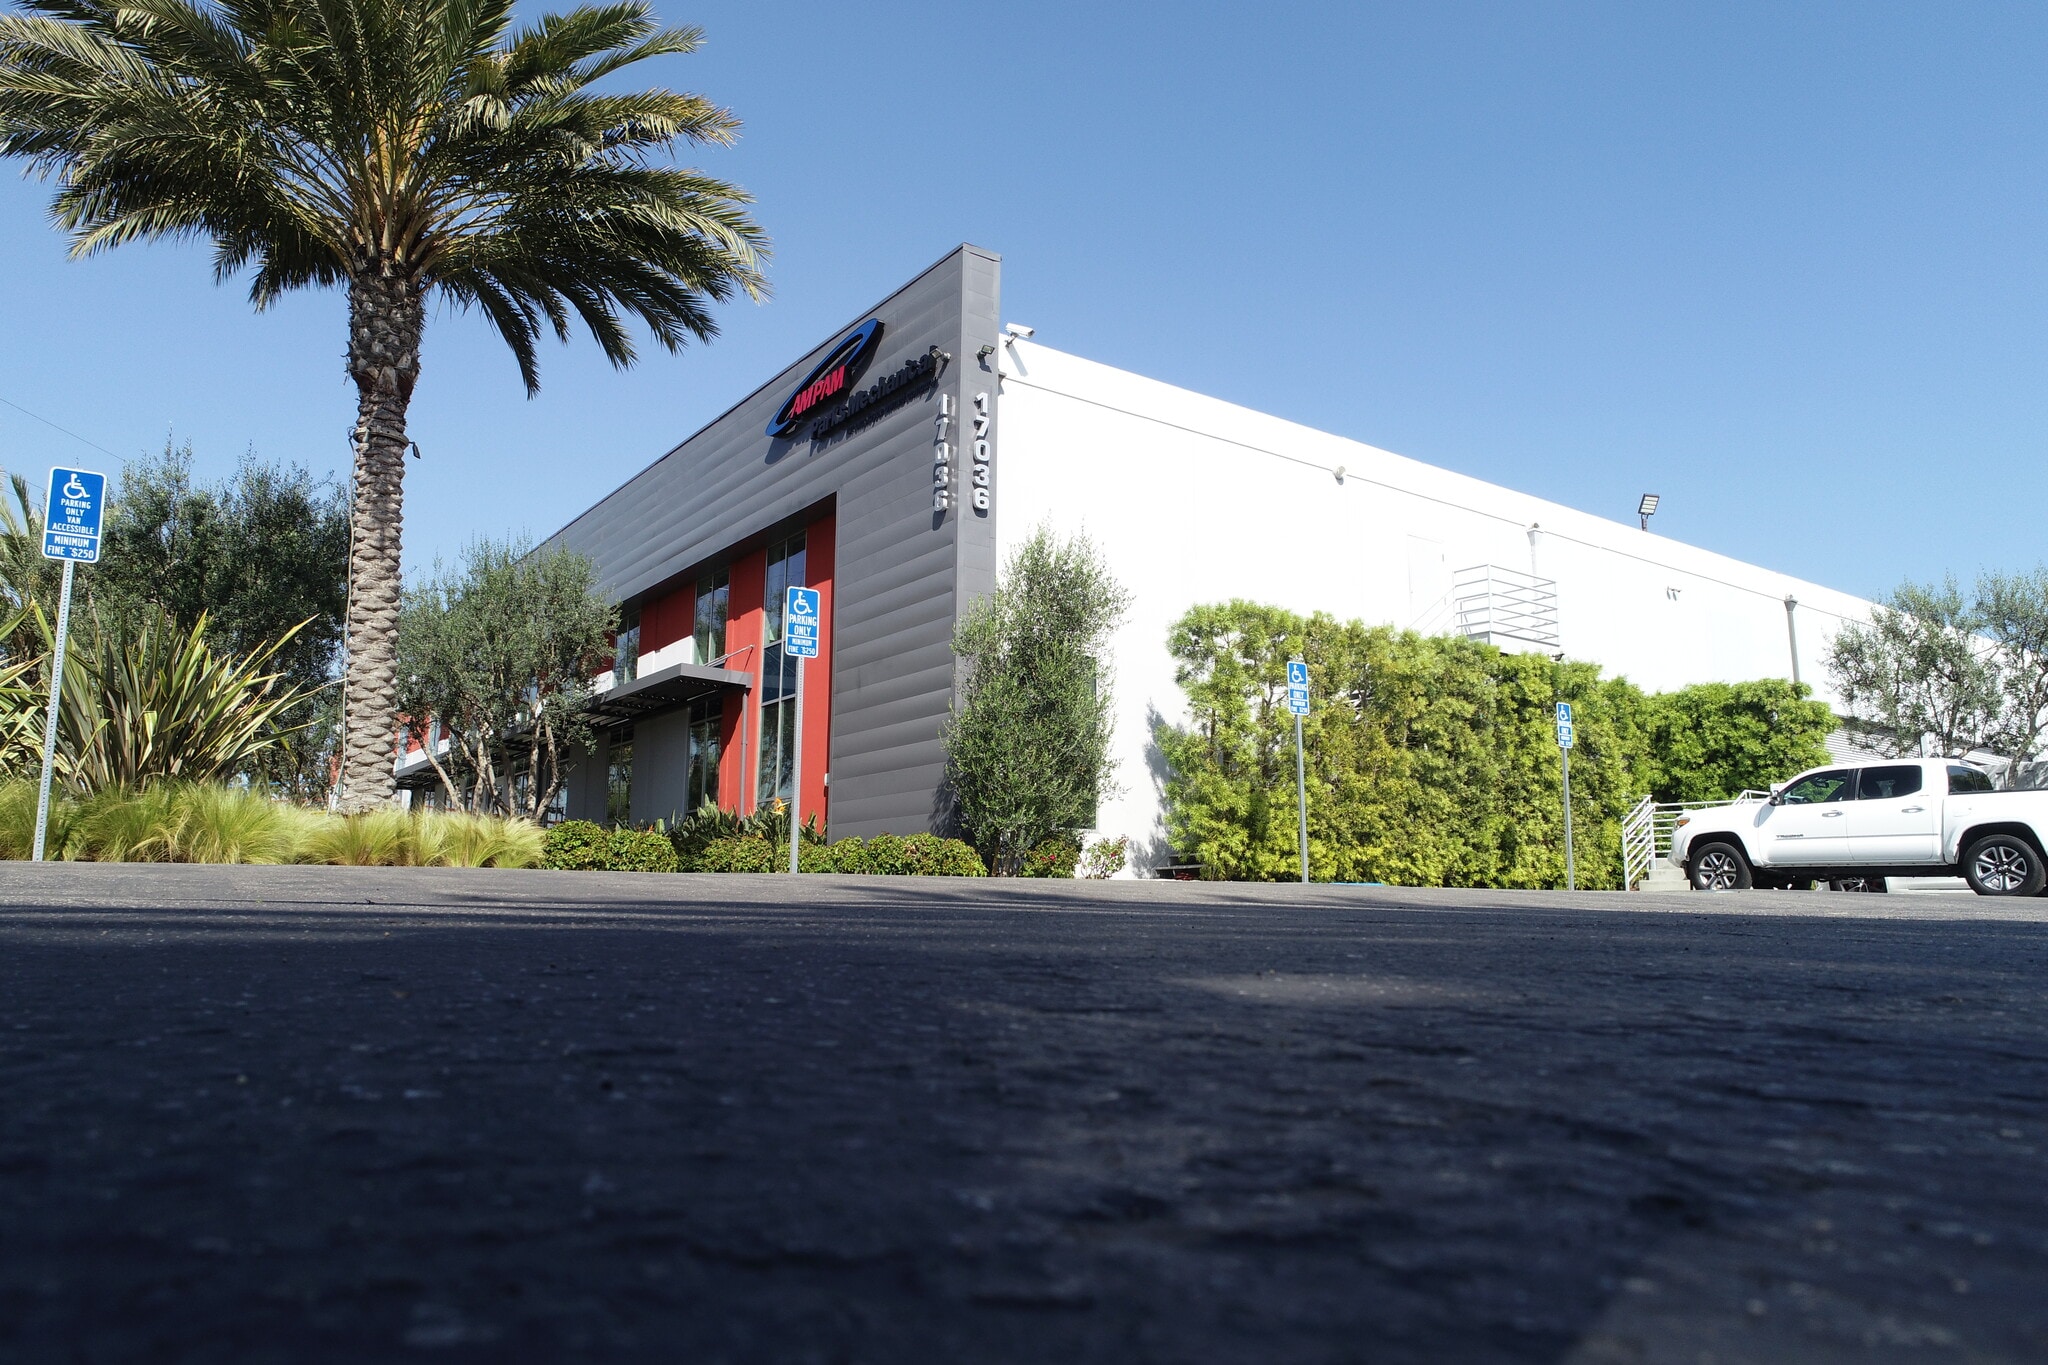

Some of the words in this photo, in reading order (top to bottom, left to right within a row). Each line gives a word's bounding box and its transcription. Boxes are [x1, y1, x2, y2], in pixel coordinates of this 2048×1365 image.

[789, 365, 846, 419] AMPAM
[810, 404, 848, 440] Parks
[973, 392, 990, 510] 17036
[61, 499, 91, 509] PARKING
[66, 508, 84, 516] ONLY
[67, 516, 81, 524] VAN
[52, 523, 94, 535] ACCESSIBLE
[54, 536, 89, 547] MINIMUM
[48, 545, 65, 555] FINE
[71, 548, 94, 558] $250
[789, 614, 816, 626] PARKING
[794, 625, 811, 636] ONLY
